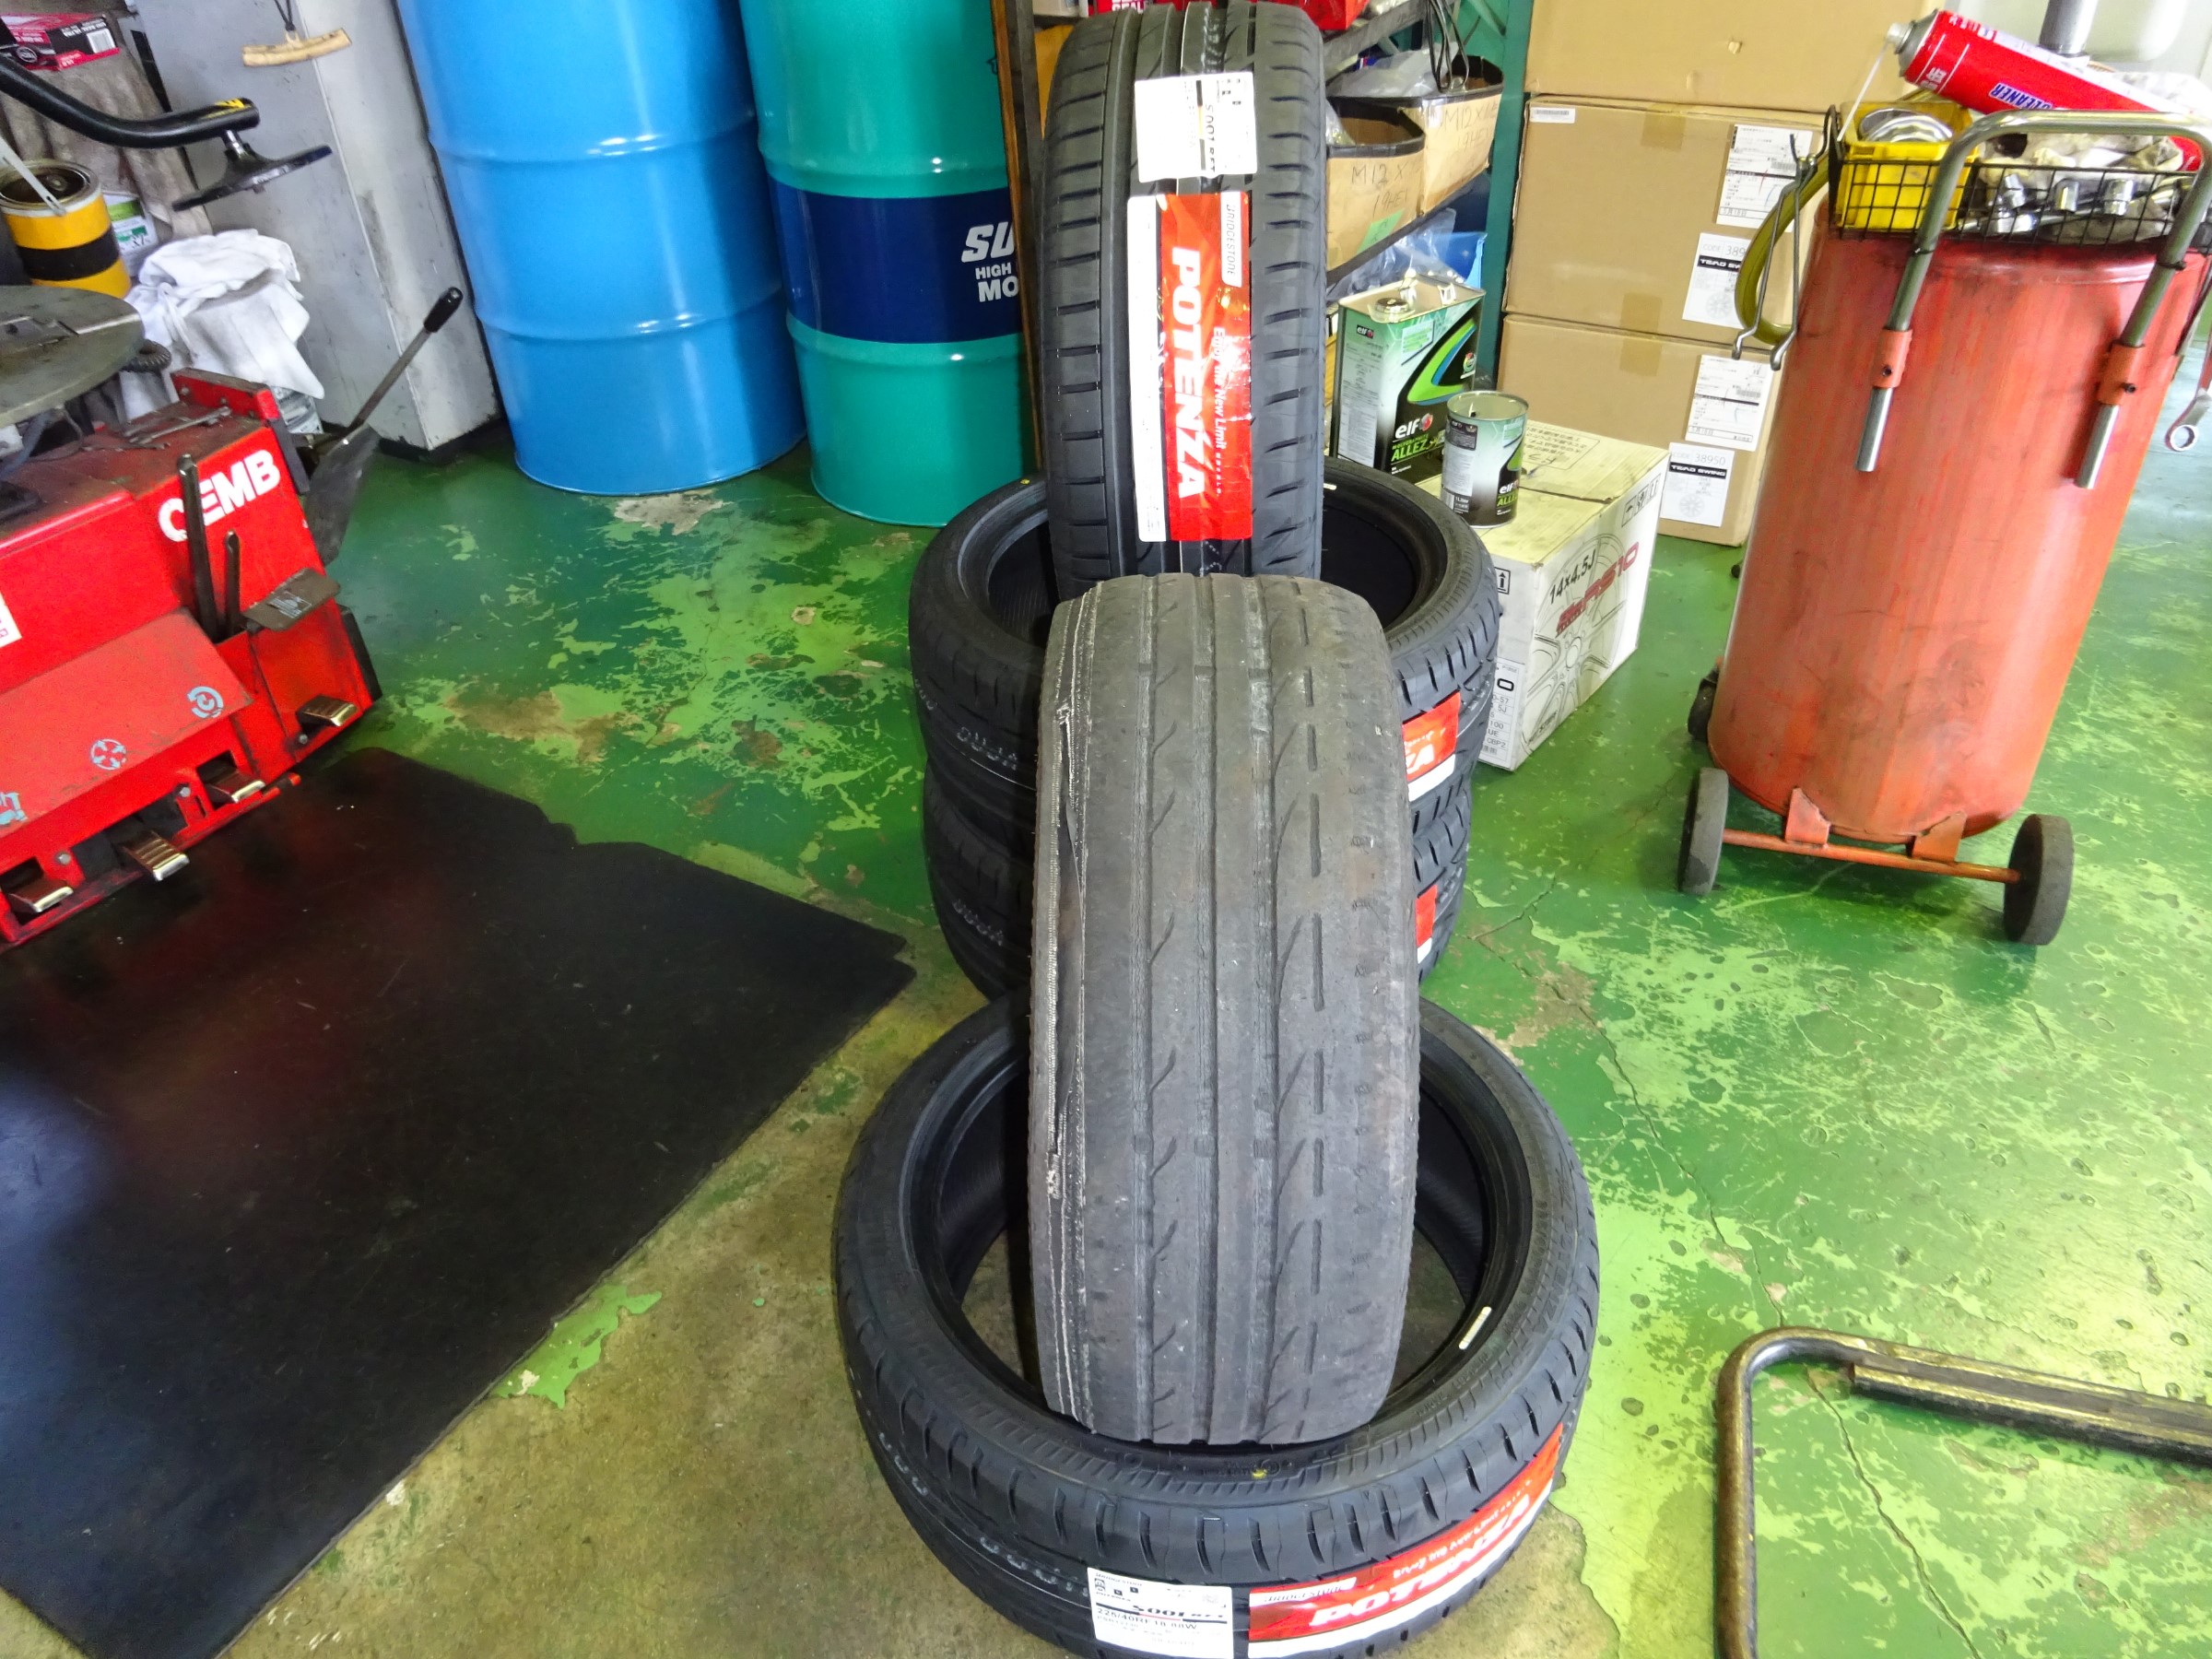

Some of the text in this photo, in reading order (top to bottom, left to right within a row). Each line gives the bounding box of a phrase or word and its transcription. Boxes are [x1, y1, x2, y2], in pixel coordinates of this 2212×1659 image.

[1226, 204, 1236, 276] BRIDGESTONE
[975, 262, 1012, 280] HIGH
[978, 276, 1018, 302] MO
[1357, 326, 1368, 335] elf
[1171, 246, 1213, 499] POTENZA
[1214, 388, 1227, 417] New
[1215, 418, 1228, 450] Limit
[1394, 418, 1420, 439] elf
[1391, 438, 1429, 462] ALLEZ
[1696, 453, 1726, 466] 38950
[1697, 468, 1726, 477] SWING
[1499, 482, 1513, 494] elf
[1309, 1493, 1530, 1626] POTENZA
